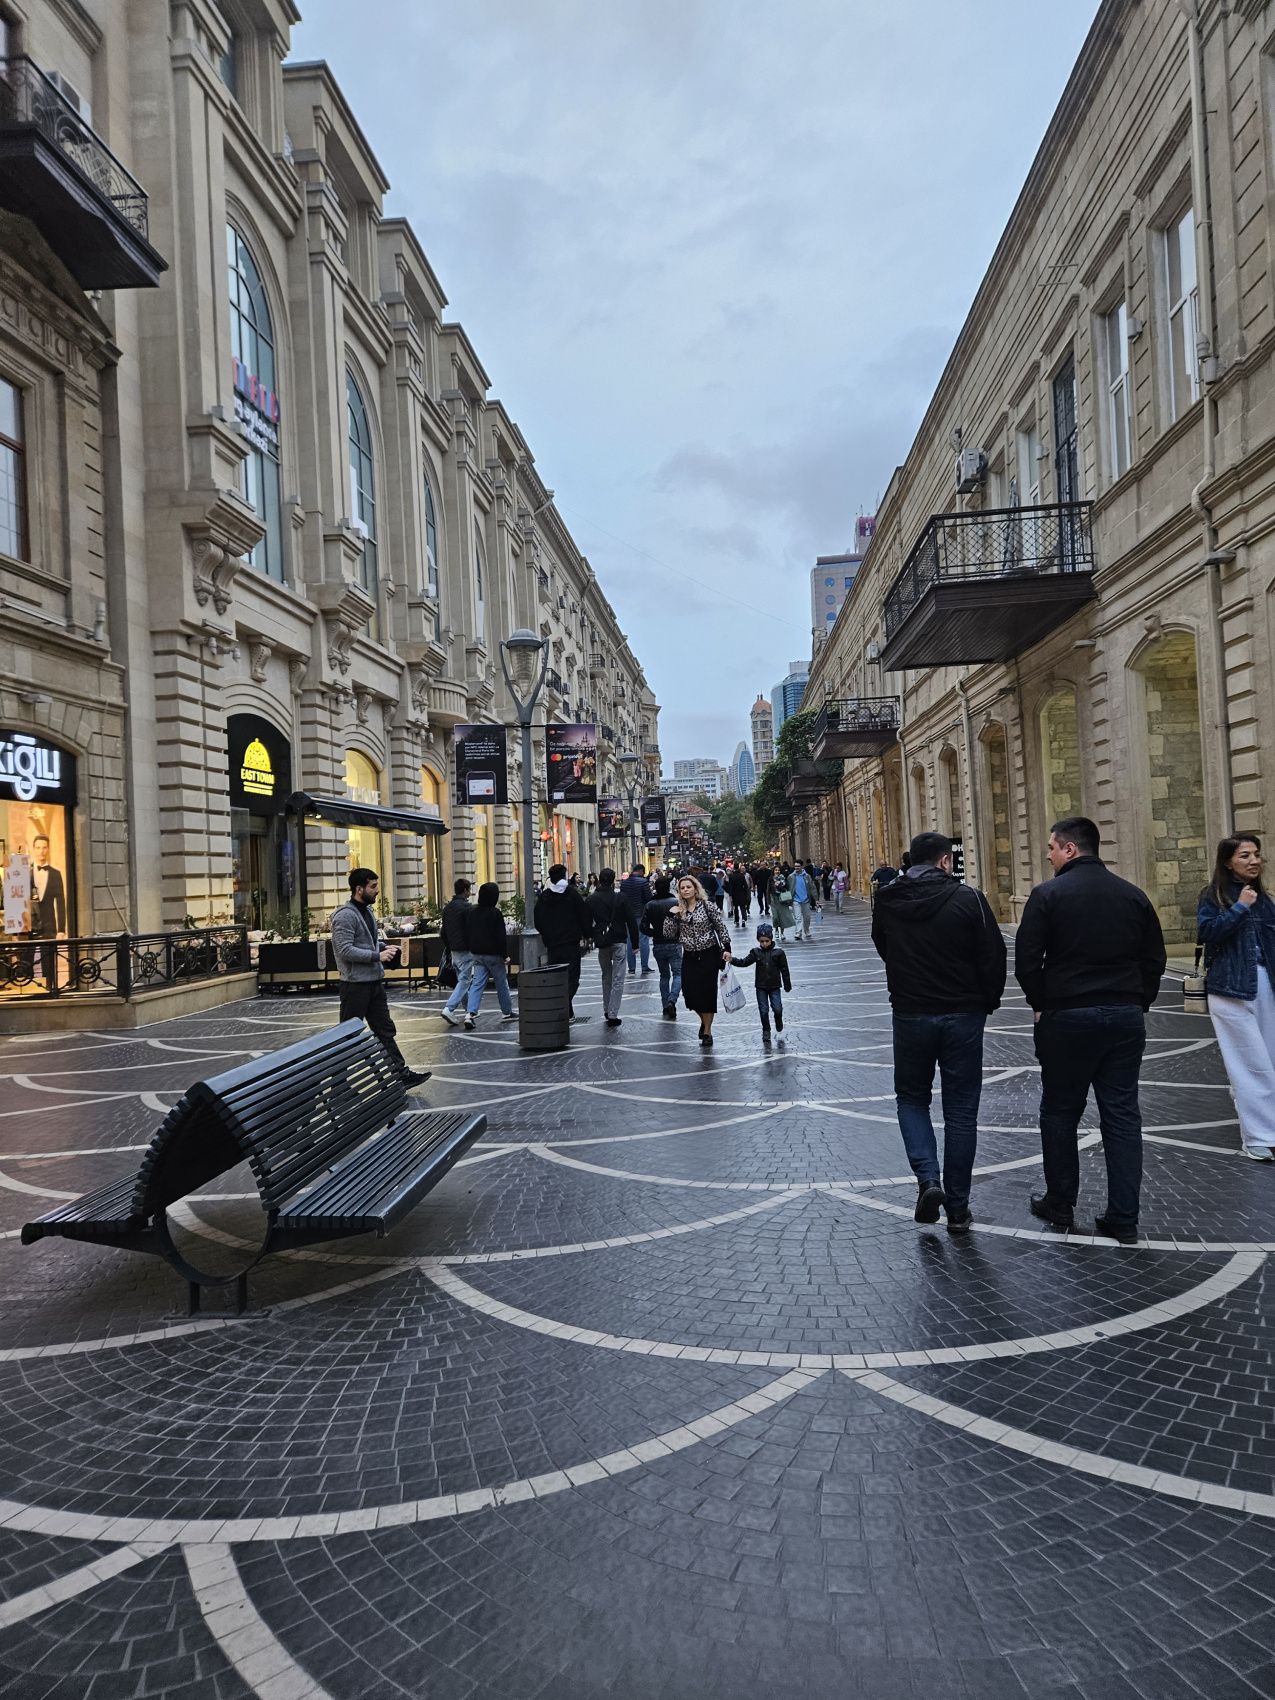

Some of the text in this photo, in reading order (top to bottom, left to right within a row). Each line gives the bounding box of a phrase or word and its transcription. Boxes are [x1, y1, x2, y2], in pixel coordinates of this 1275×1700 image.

[240, 768, 275, 785] EAST TOWN
[10, 885, 24, 898] SALE
